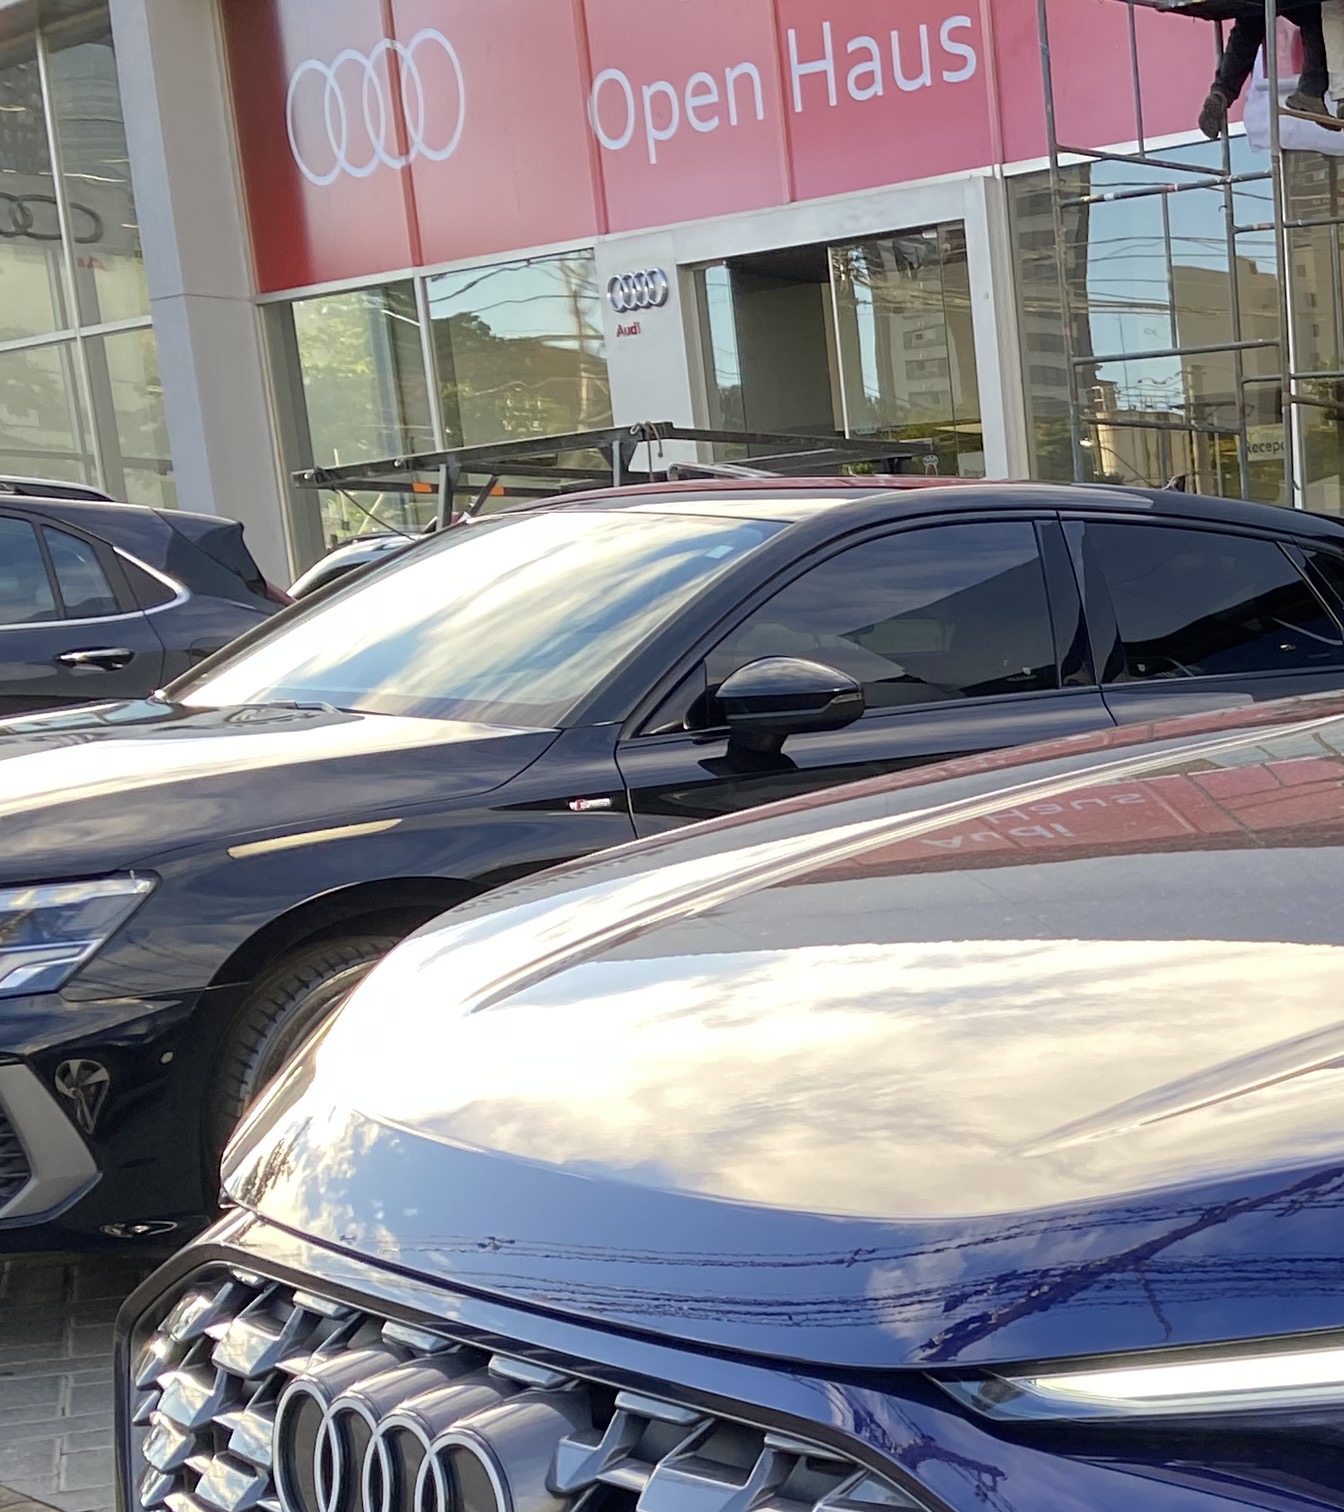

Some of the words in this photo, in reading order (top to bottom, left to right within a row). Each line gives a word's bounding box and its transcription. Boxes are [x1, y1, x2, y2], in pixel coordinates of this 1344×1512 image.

[588, 61, 764, 164] Open
[787, 15, 977, 113] Haus
[616, 321, 642, 338] Audi
